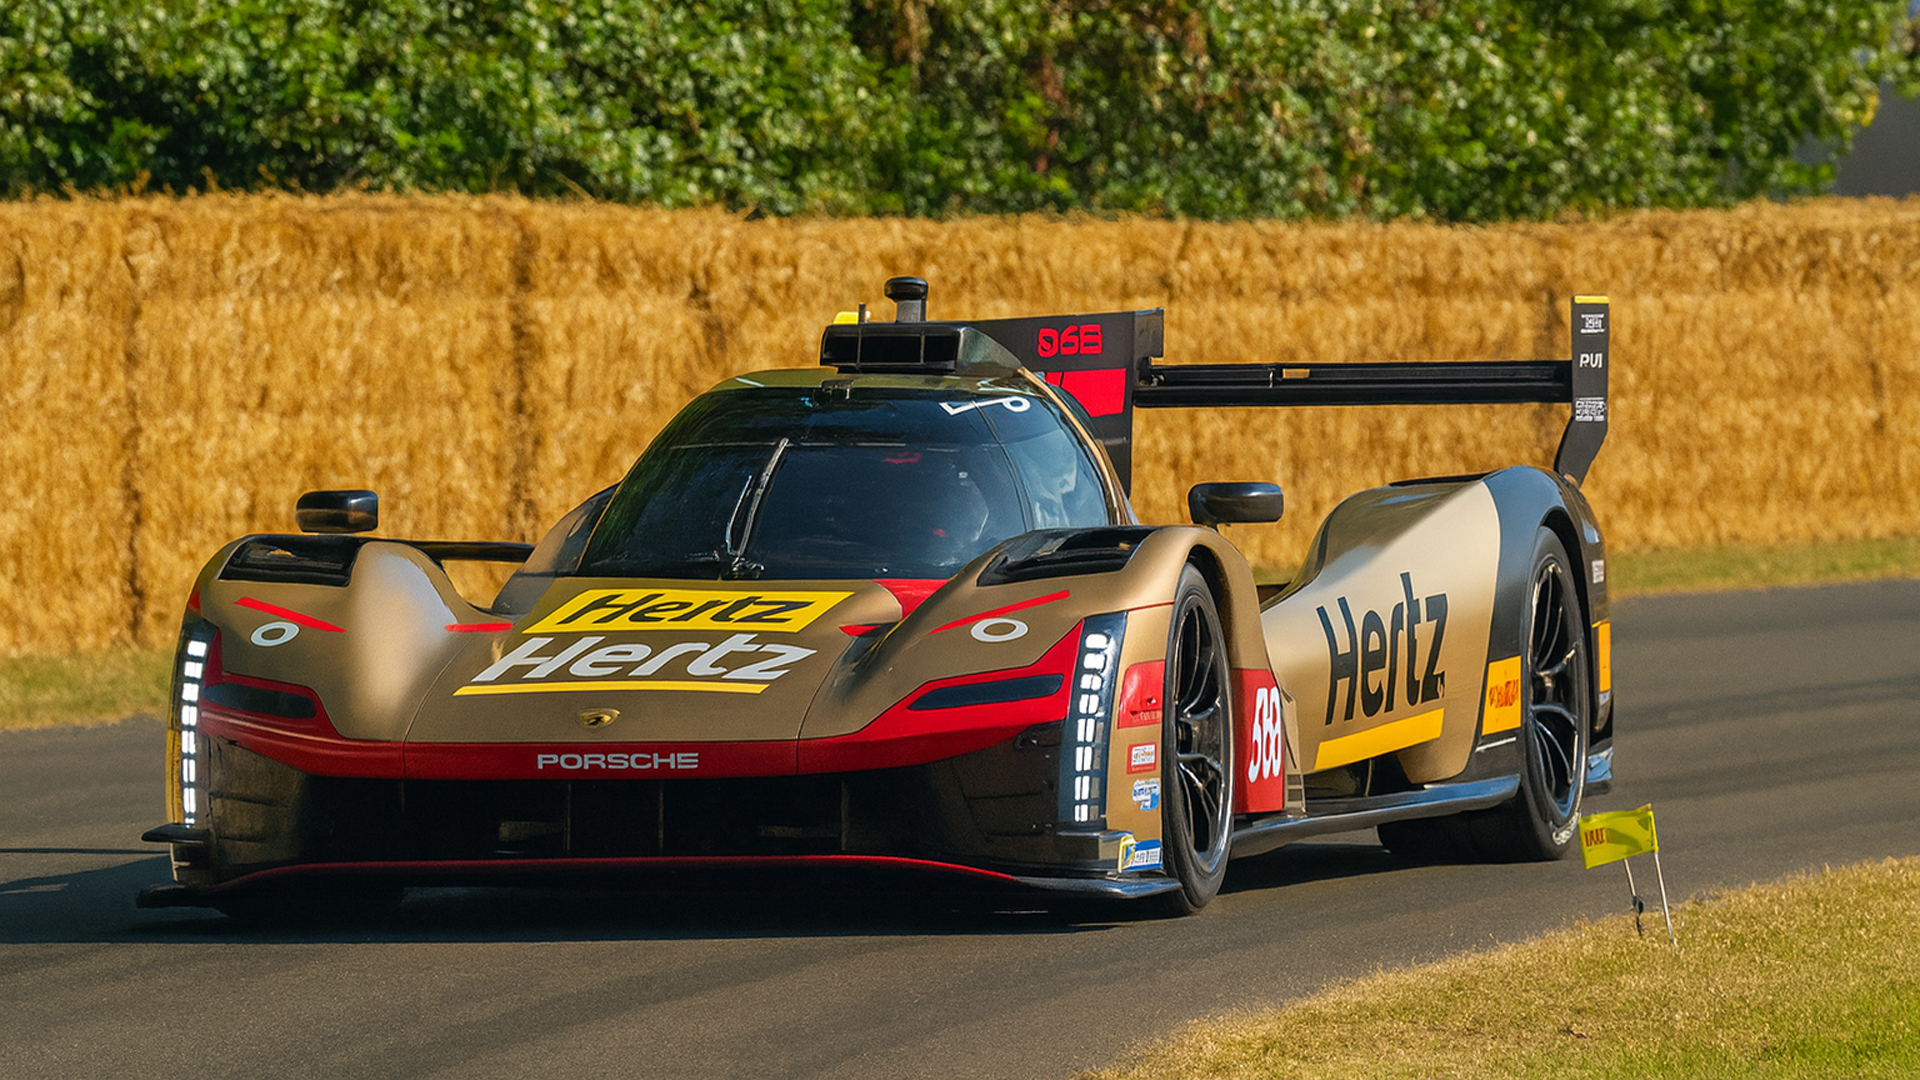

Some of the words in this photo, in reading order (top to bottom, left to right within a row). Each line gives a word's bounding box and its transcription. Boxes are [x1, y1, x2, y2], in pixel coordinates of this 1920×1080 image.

[556, 593, 815, 625] Hertz
[471, 633, 818, 683] Hertz
[1316, 571, 1448, 726] Hertz
[537, 752, 699, 770] PORSCHE
